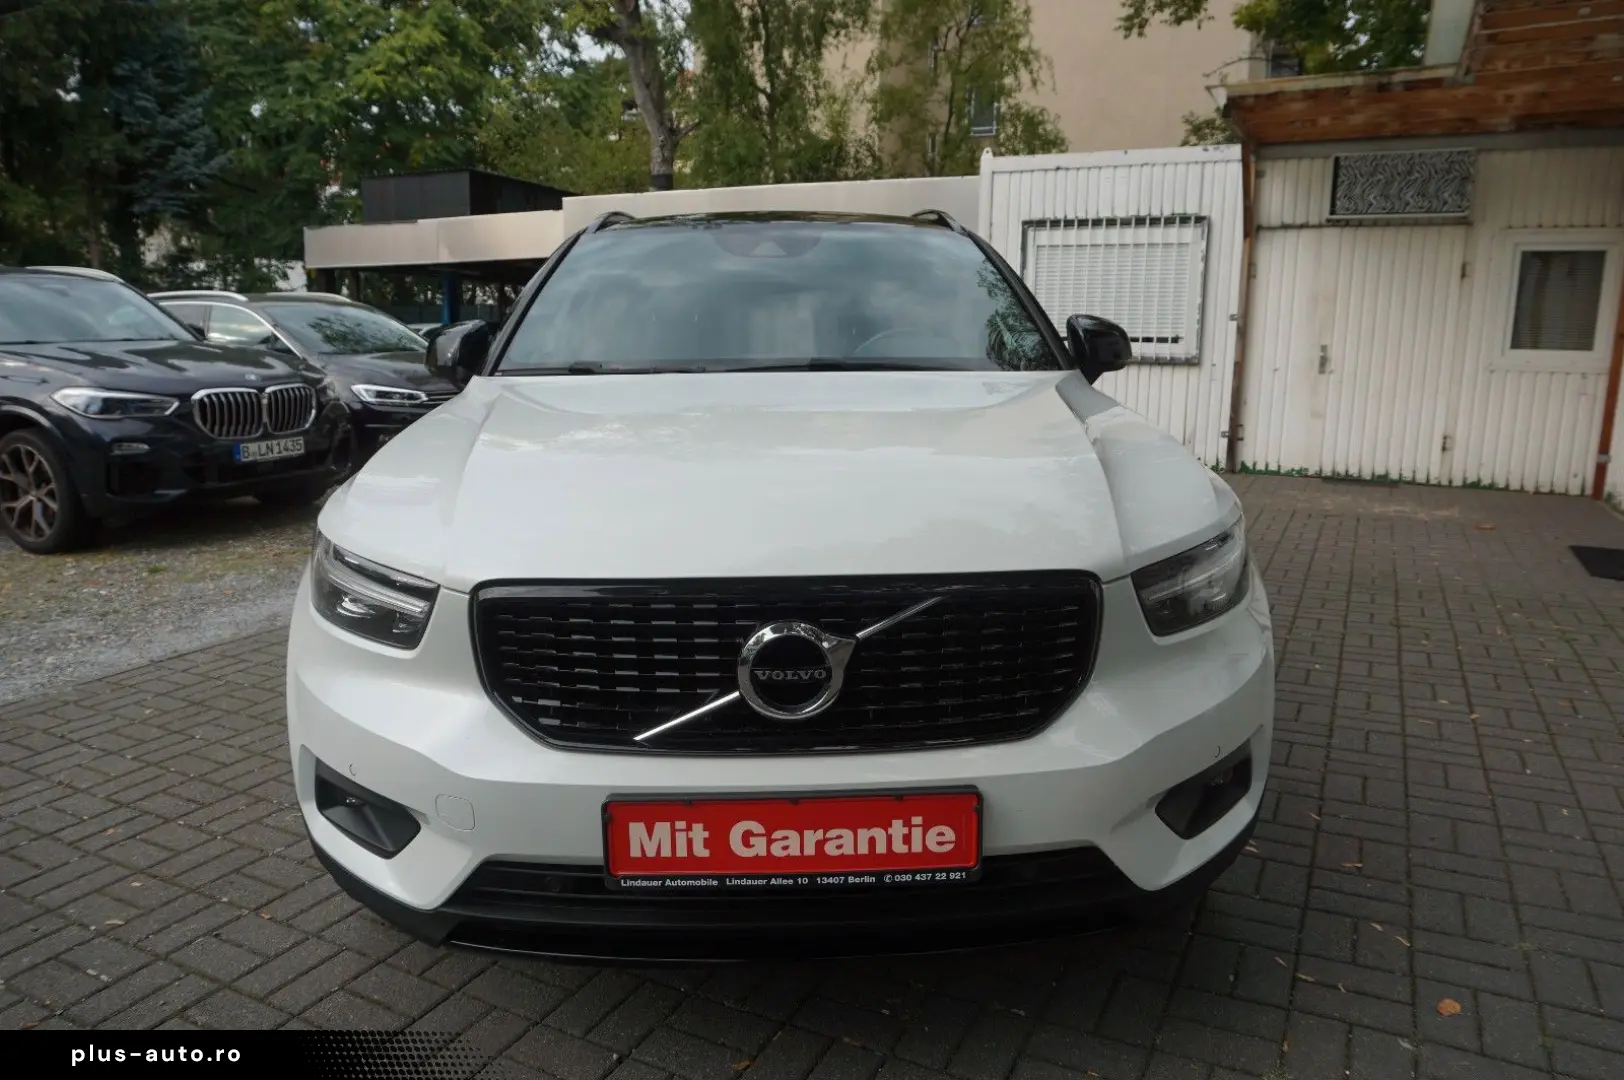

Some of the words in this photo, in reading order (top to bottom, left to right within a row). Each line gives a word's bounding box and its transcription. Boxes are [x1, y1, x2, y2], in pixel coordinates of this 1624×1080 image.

[242, 445, 250, 459] B
[754, 669, 827, 681] VOLVO
[628, 820, 711, 858] Mit
[729, 816, 956, 858] Garantie
[620, 878, 663, 887] Lindauer
[665, 878, 719, 887] Automobile
[725, 877, 768, 886] Lindauer
[769, 877, 794, 885] Allee
[796, 876, 809, 885] 10
[816, 876, 845, 884] 13407
[847, 875, 876, 883] Berlin
[894, 873, 913, 882] 030
[915, 873, 932, 881] 437
[935, 872, 947, 880] 22
[949, 871, 967, 879] 921
